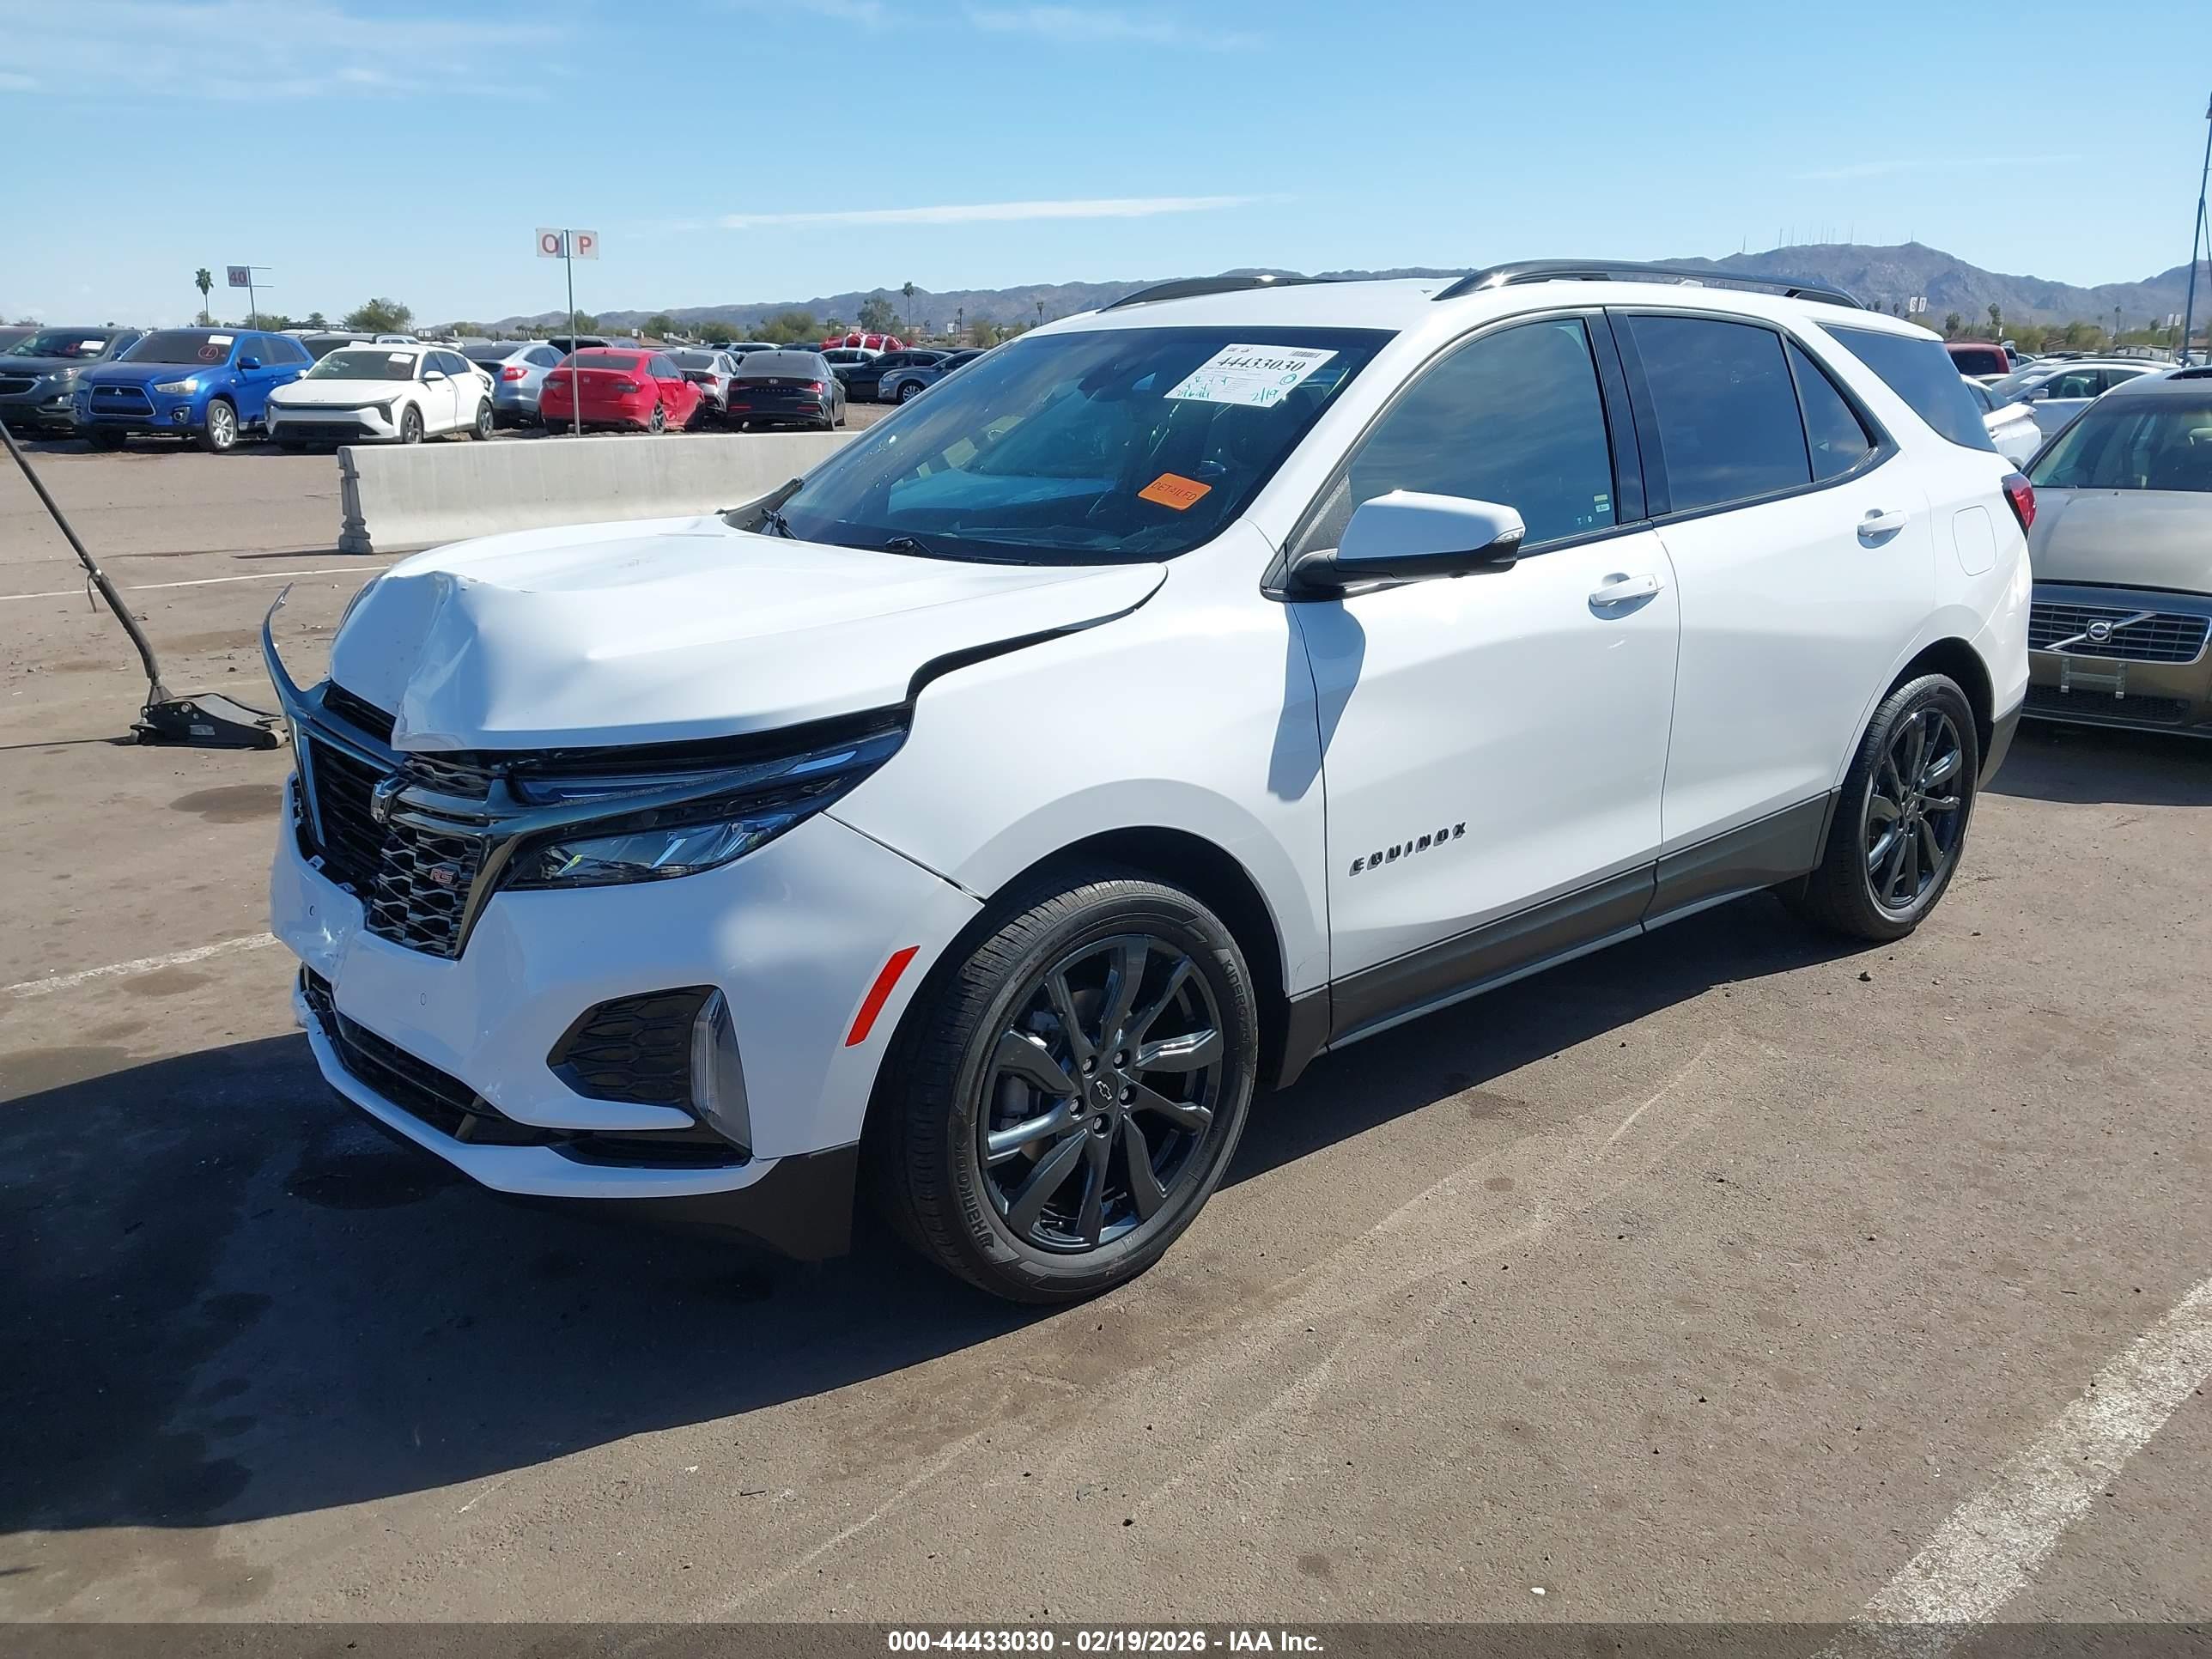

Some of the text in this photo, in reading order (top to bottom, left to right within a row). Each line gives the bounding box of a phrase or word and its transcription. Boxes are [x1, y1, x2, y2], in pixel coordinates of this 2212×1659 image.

[542, 234, 559, 254] O
[579, 235, 592, 255] P
[1216, 357, 1306, 372] 44433030
[1351, 822, 1466, 874] EQUINOX
[430, 867, 454, 884] RS
